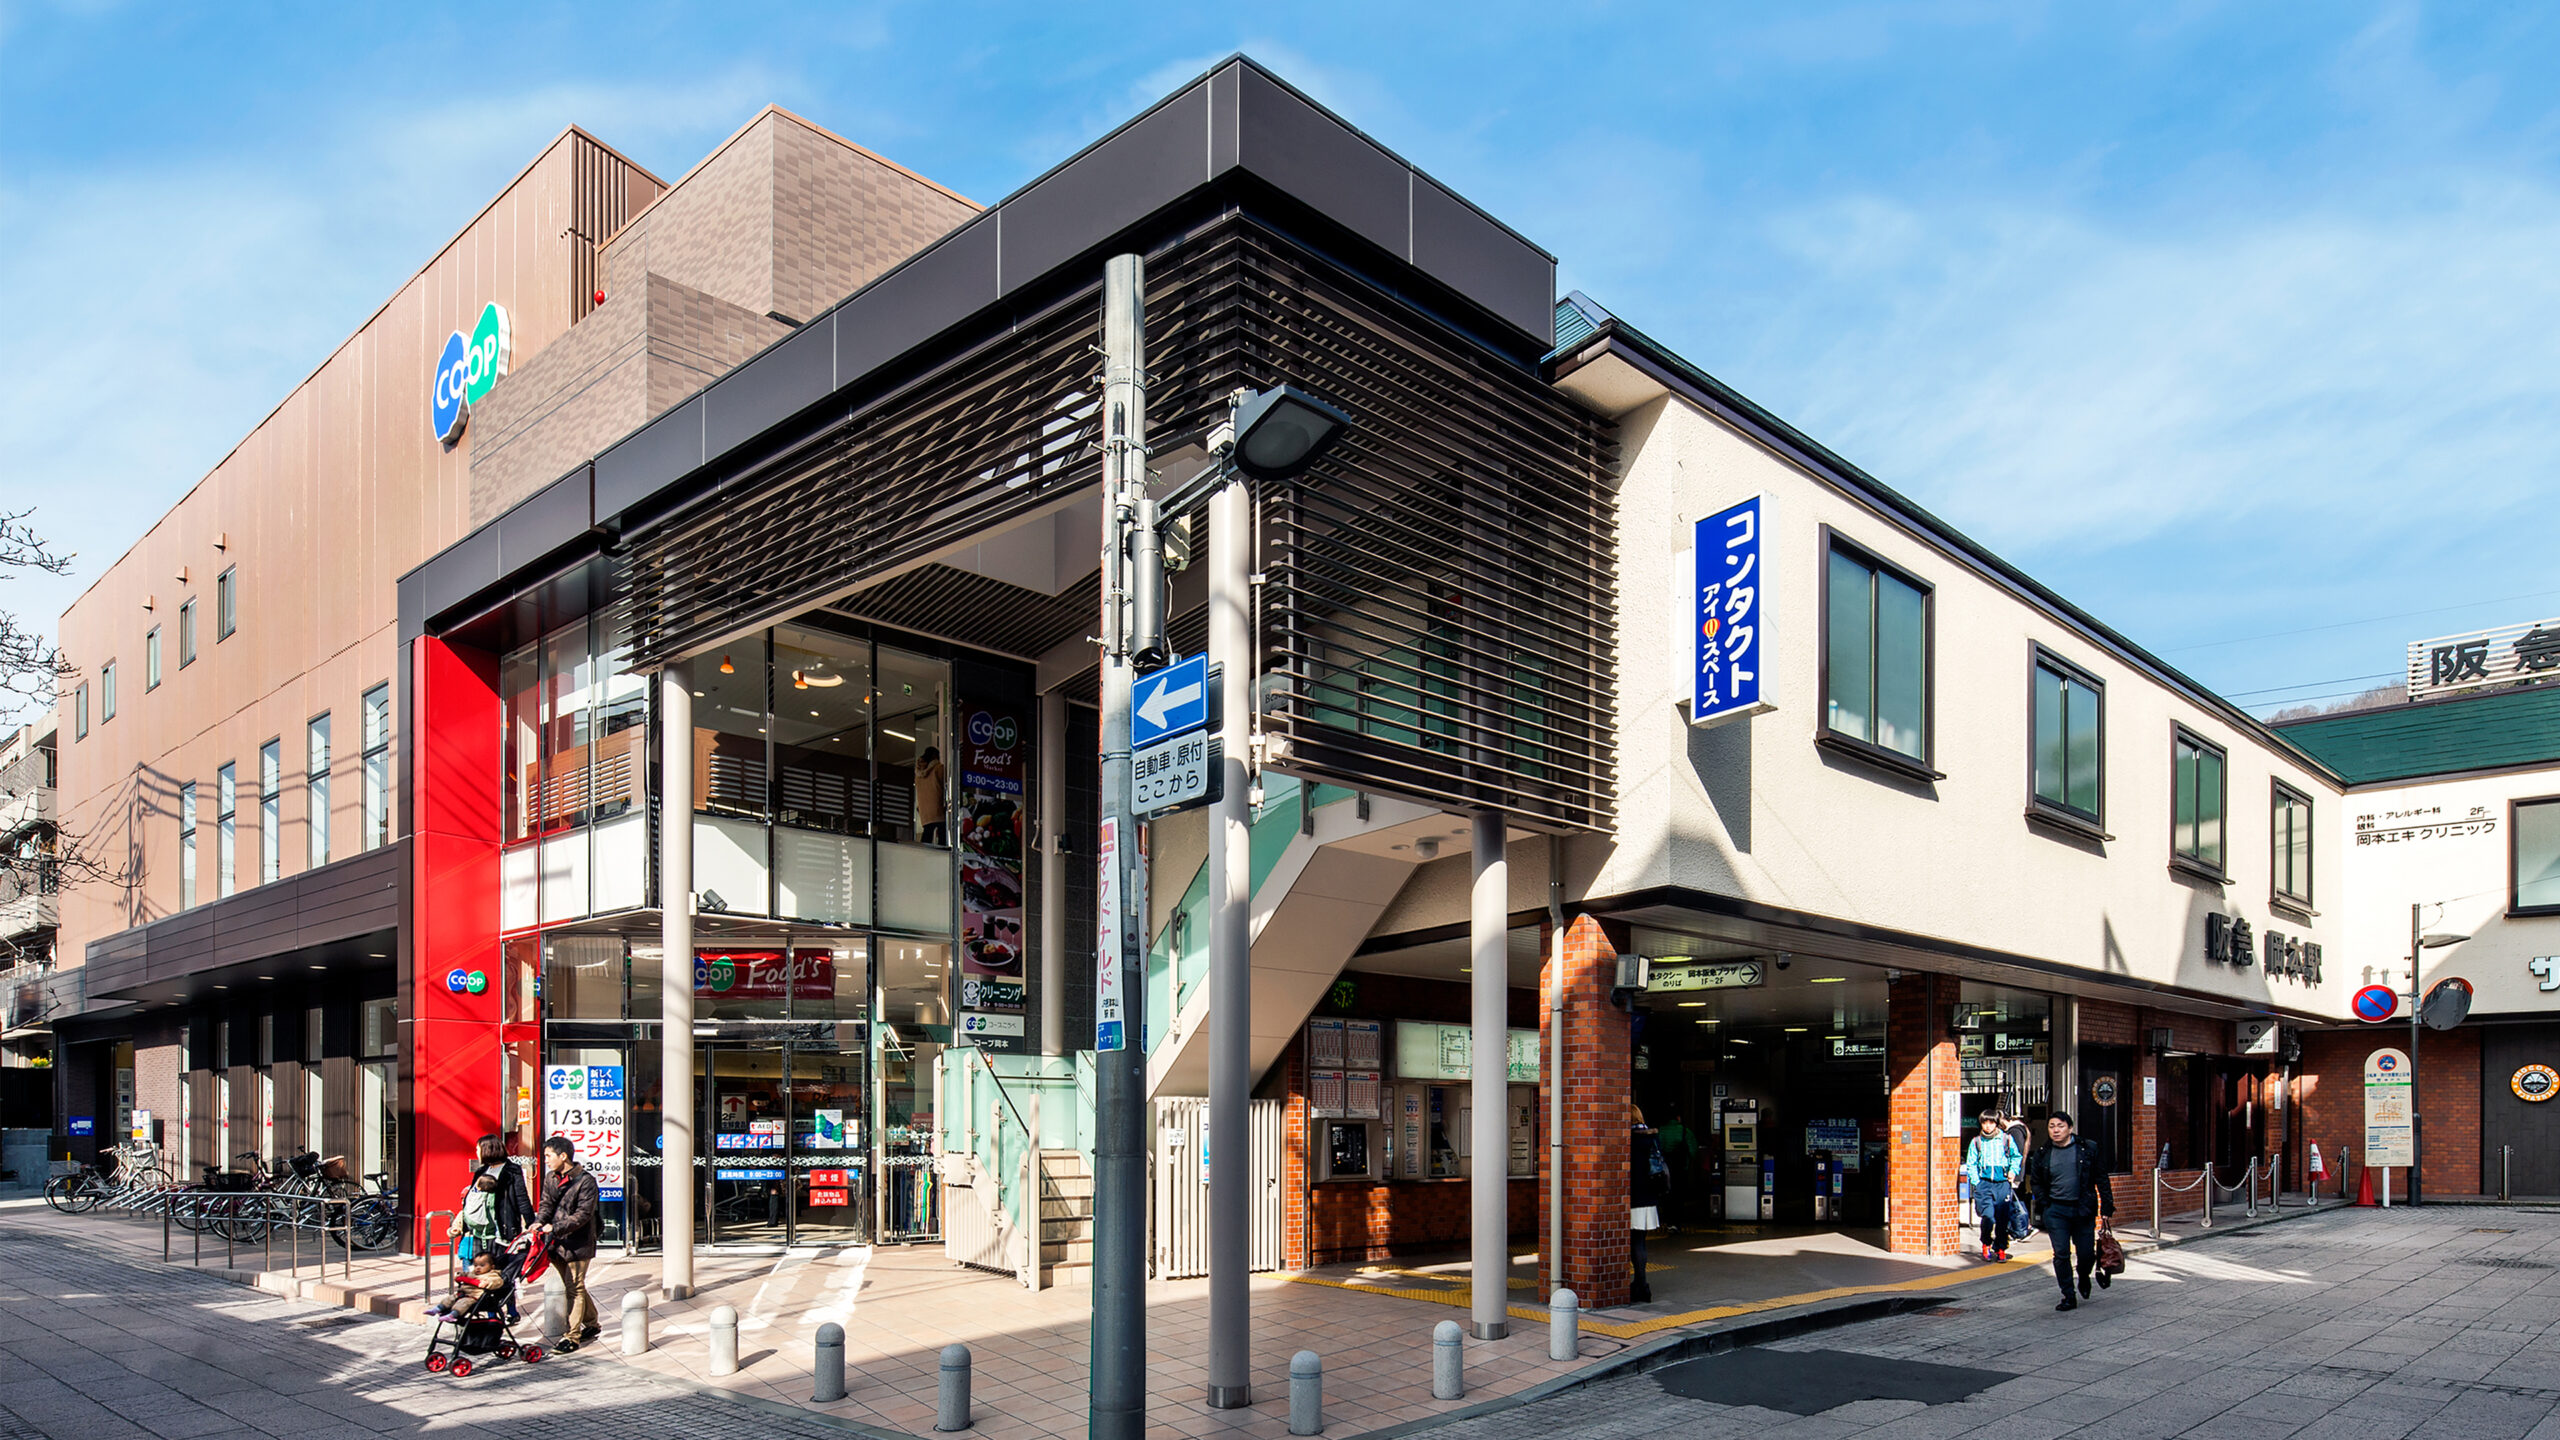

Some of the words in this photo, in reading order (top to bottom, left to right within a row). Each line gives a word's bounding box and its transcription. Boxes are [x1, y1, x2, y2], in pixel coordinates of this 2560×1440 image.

[1724, 509, 1756, 699] コンタクト
[2431, 628, 2560, 686] 阪急
[971, 720, 1015, 741] COOP
[973, 749, 1012, 766] Food's
[1135, 740, 1204, 781] 自動車・原付
[1137, 769, 1200, 804] ここから
[2470, 806, 2485, 816] 2F
[1099, 855, 1113, 995] マクドナルド
[2206, 911, 2254, 967] 阪急
[2265, 930, 2322, 984] 岡本駅
[746, 956, 822, 989] Food's
[1687, 966, 1738, 978] 岡本阪急プラザ
[449, 974, 484, 987] COOP
[980, 984, 1022, 1001] クリーニング
[974, 1039, 1009, 1048] コープ岡本
[550, 1074, 584, 1085] COOP
[590, 1068, 612, 1078] 新しく
[590, 1079, 615, 1088] 生まれ
[590, 1088, 623, 1098] 変わって
[550, 1109, 593, 1125] 1/31
[597, 1116, 622, 1126] 9:00
[721, 1112, 737, 1121] 2F
[573, 1143, 622, 1158] ープン
[600, 1190, 623, 1198] 23:00
